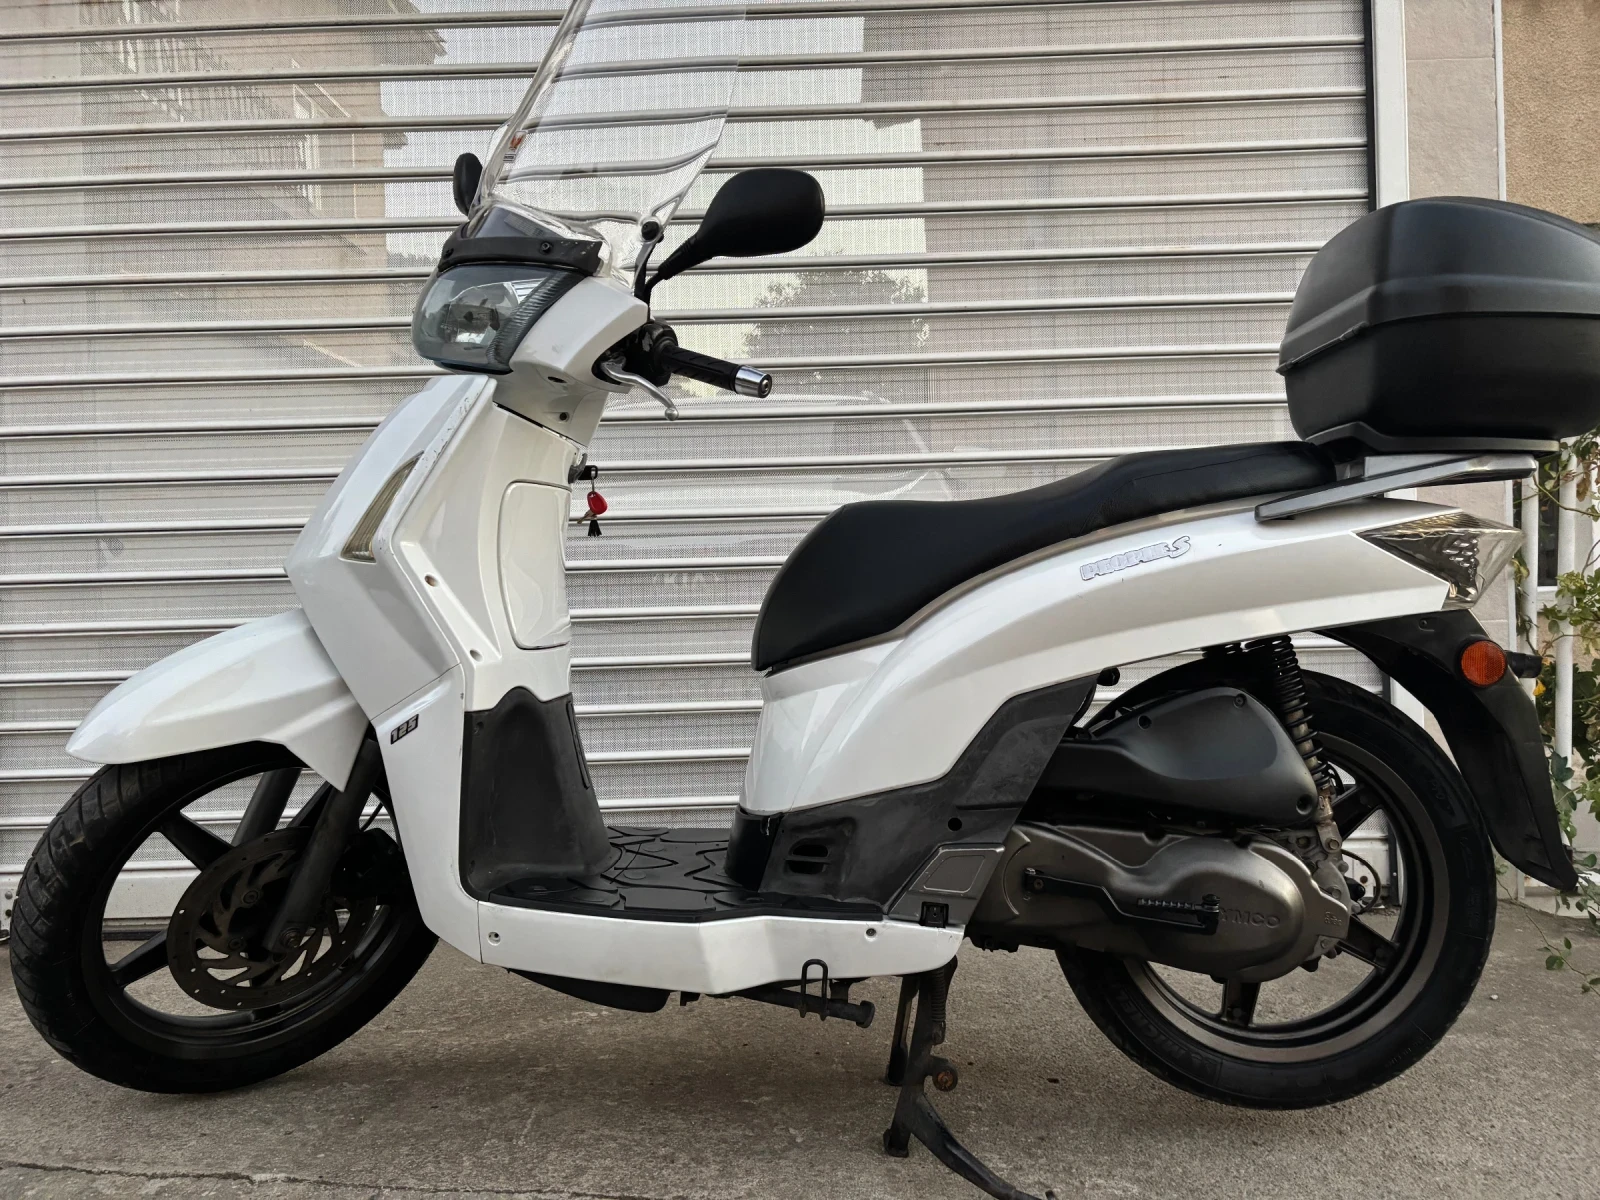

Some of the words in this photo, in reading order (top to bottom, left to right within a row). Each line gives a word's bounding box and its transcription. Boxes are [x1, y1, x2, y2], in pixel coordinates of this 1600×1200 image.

[391, 714, 419, 745] 125
[1219, 906, 1280, 929] YMCO
[1114, 987, 1188, 1060] MICHEL
